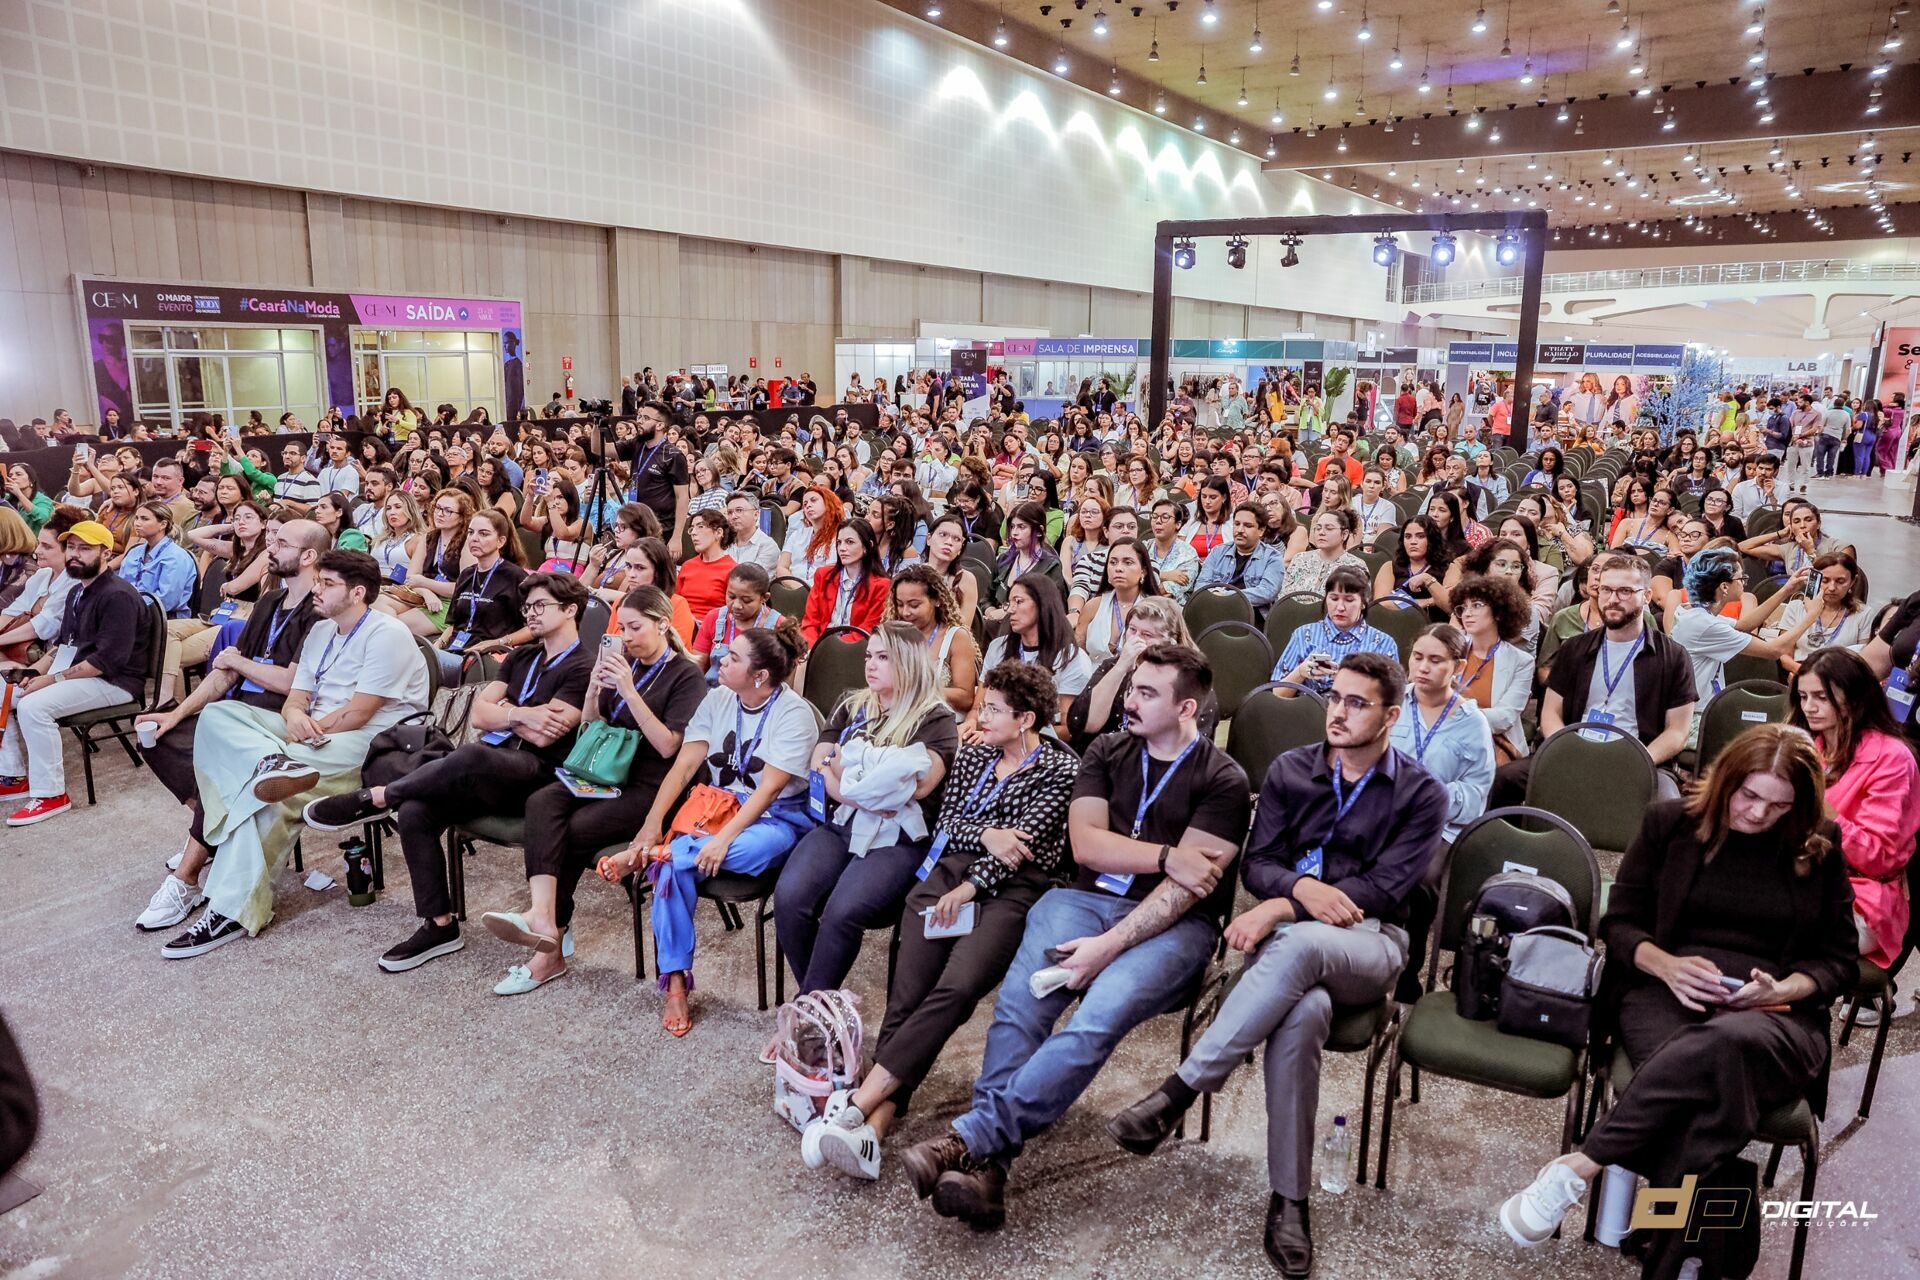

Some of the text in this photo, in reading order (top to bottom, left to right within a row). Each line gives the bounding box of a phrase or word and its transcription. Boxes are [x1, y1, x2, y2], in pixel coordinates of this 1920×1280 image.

[156, 293, 165, 301] O
[165, 294, 193, 302] MAIOR
[158, 303, 194, 312] EVENTO
[239, 297, 341, 314] #CearáNaModa
[406, 302, 456, 321] SAÍDA
[1038, 343, 1136, 354] SALA DE IMPRENSA
[1586, 351, 1632, 359] PLURALIDADE
[1788, 362, 1818, 371] LAB
